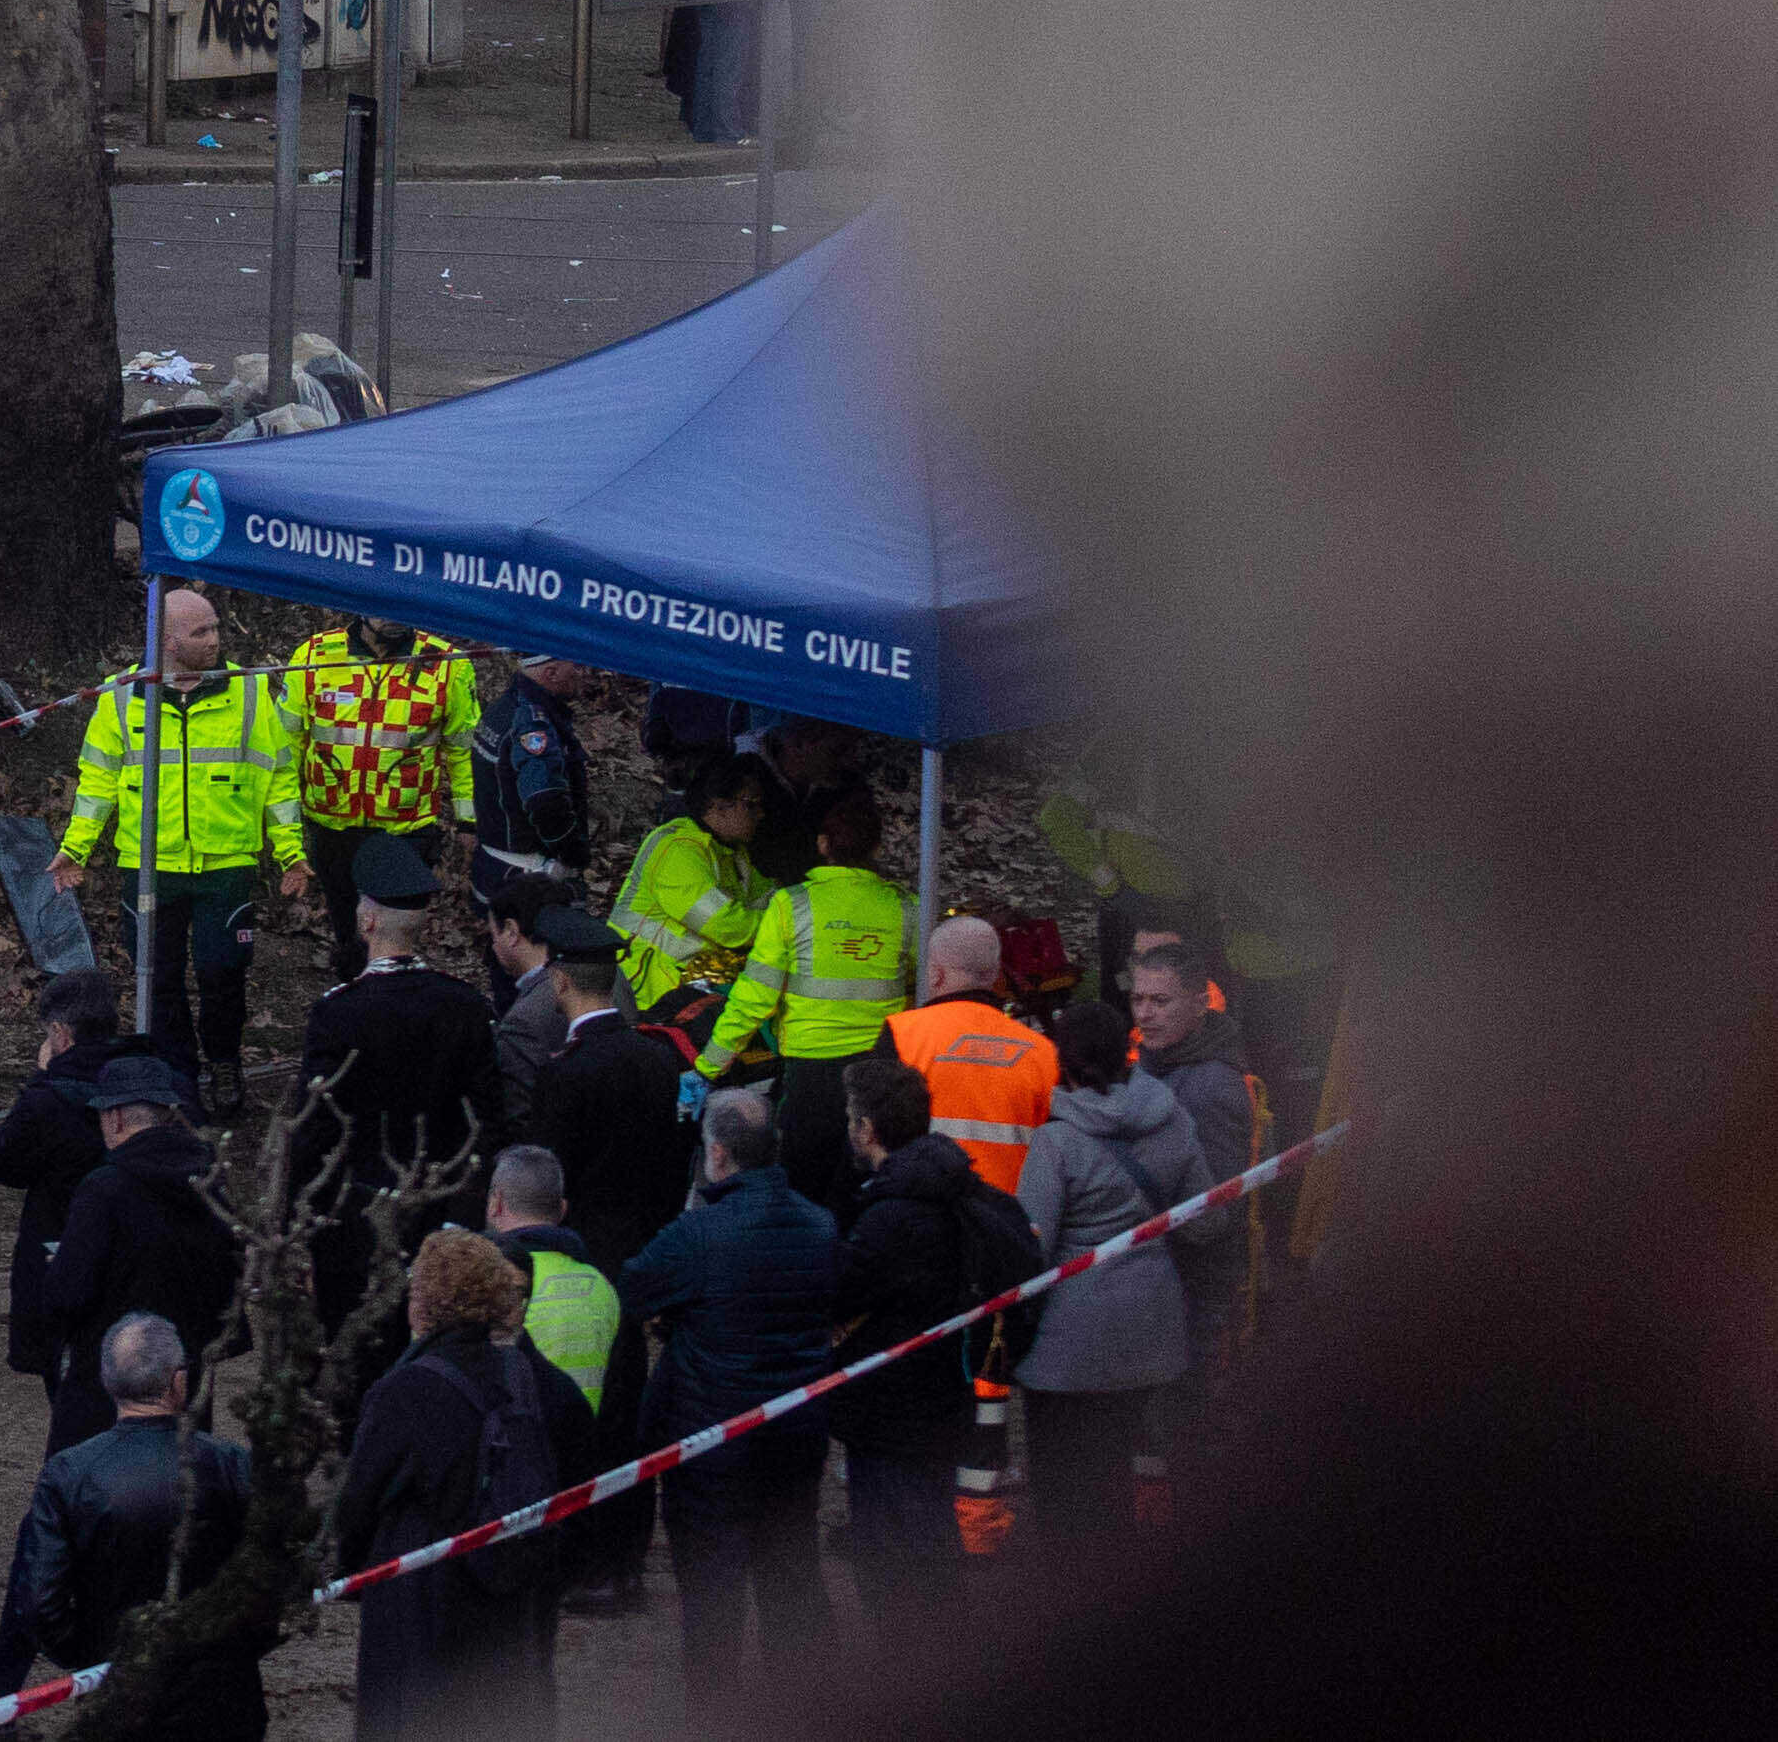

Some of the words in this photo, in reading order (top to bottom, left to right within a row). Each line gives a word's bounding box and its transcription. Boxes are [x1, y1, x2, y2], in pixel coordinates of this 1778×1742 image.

[245, 513, 375, 567] COMUNE
[393, 542, 423, 576] DI
[443, 551, 562, 601] MILANO
[580, 578, 786, 653] PROTEZIONE
[805, 629, 912, 680] CIVILE
